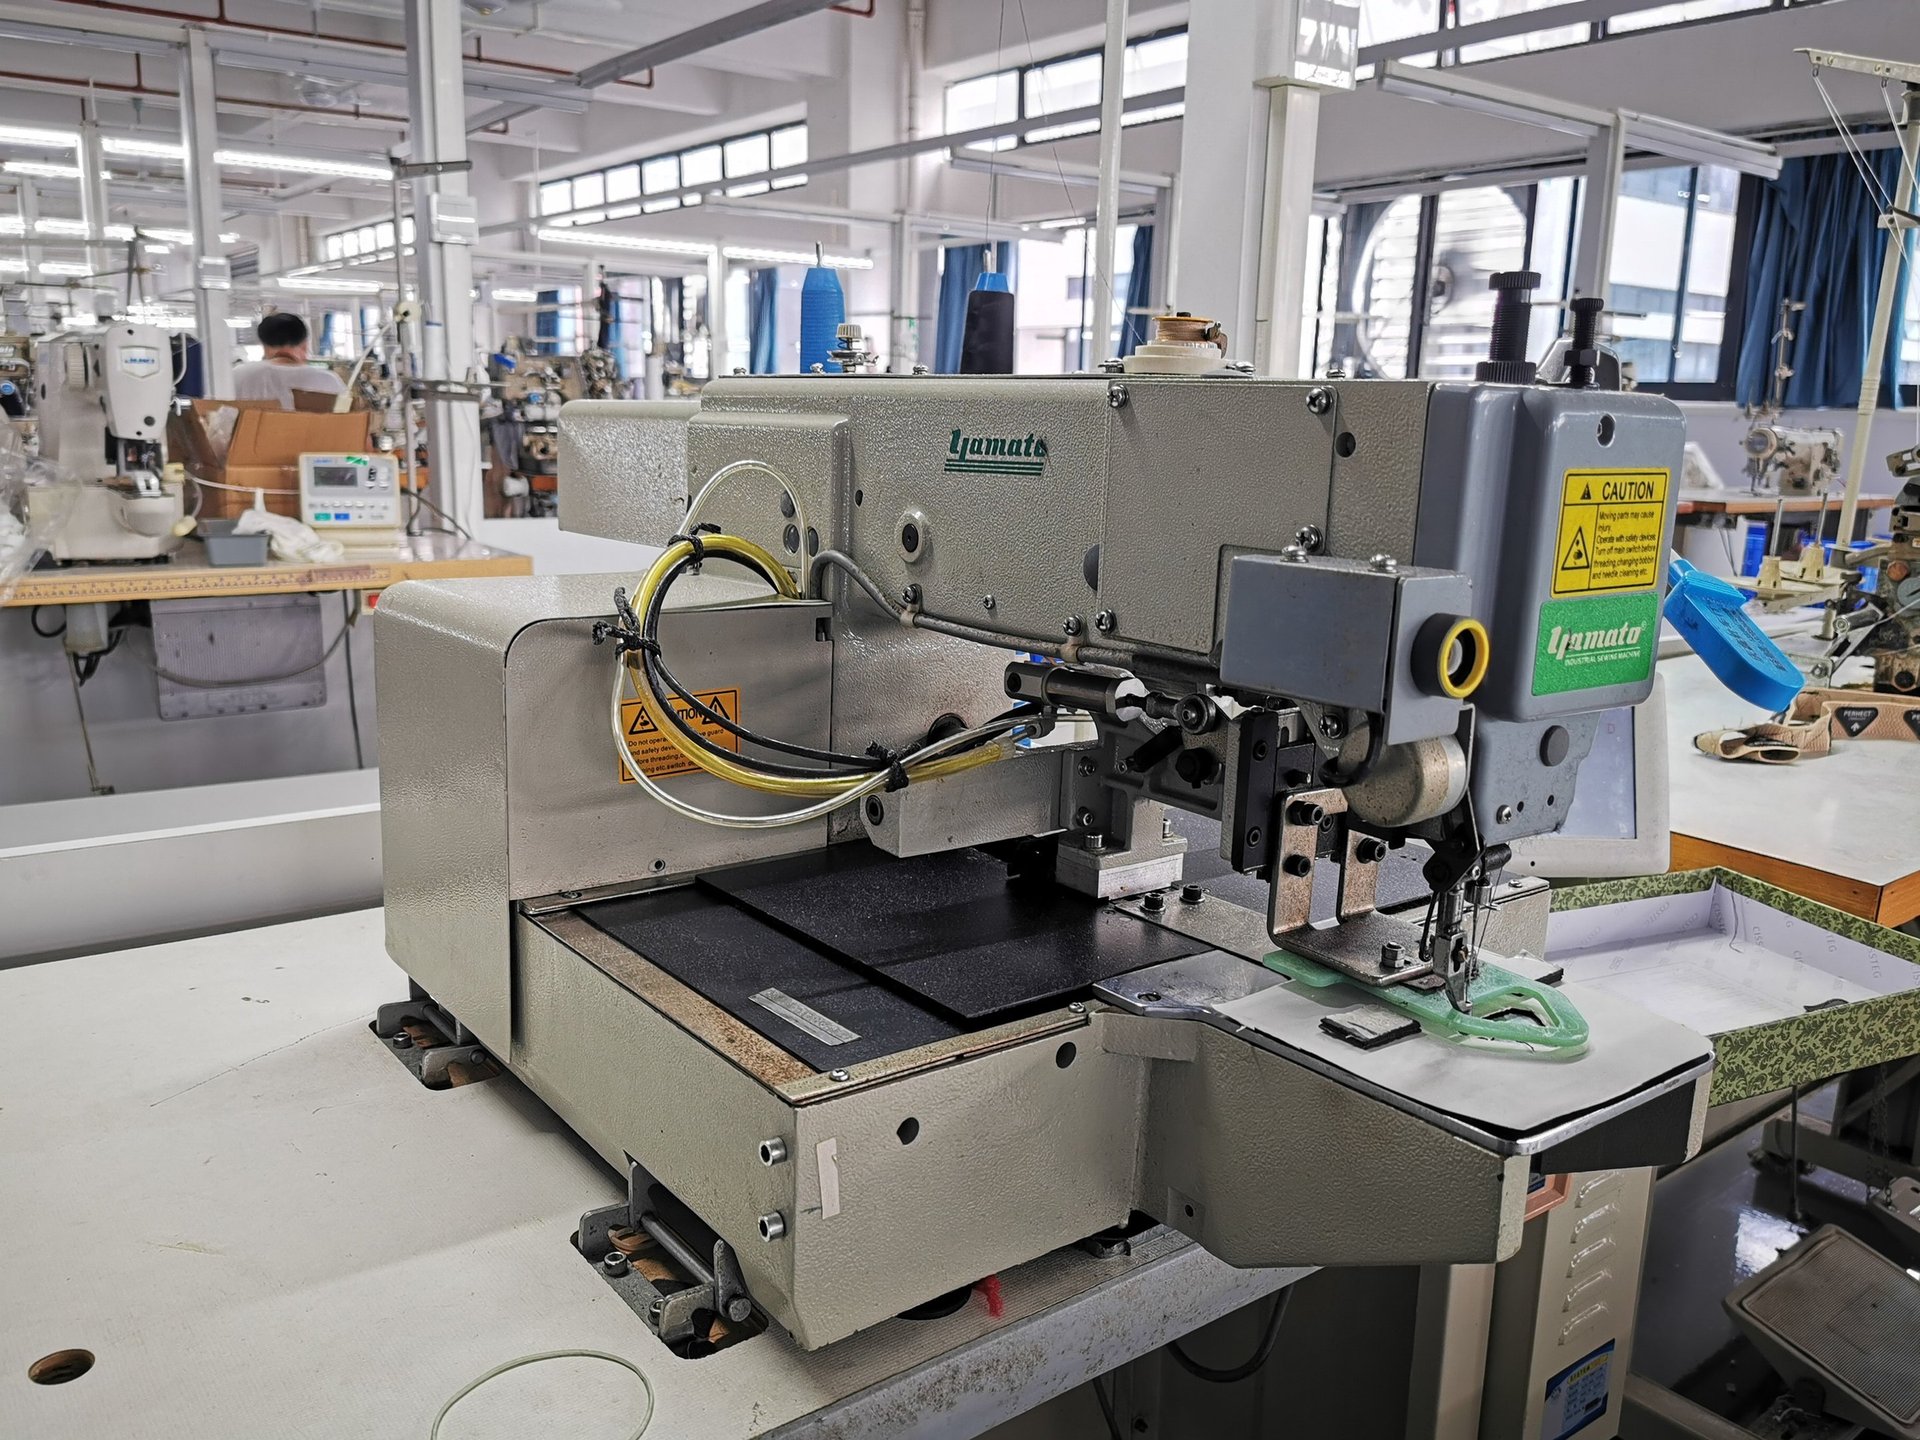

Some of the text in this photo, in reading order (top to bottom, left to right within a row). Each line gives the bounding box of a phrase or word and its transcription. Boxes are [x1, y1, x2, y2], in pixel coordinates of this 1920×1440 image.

[949, 428, 1047, 462] Yamato
[1602, 482, 1654, 500] CAUTION
[1600, 511, 1616, 521] Moving
[1617, 511, 1629, 520] parts
[1630, 511, 1639, 520] may
[1597, 535, 1614, 544] Operate
[1616, 534, 1625, 542] with
[1625, 534, 1638, 543] safety
[1595, 546, 1606, 555] Turn
[1614, 546, 1625, 554] main
[1626, 545, 1641, 553] switch
[1641, 543, 1656, 552] before
[1639, 556, 1654, 564] bobbin
[1592, 571, 1602, 580] and
[1547, 621, 1642, 660] Yamato
[1564, 650, 1641, 666] INDUSTRIAL SEWING MACHINE
[677, 708, 702, 720] TION
[638, 738, 649, 746] not
[649, 737, 669, 745] opera
[707, 728, 724, 738] guard
[641, 747, 660, 756] safety
